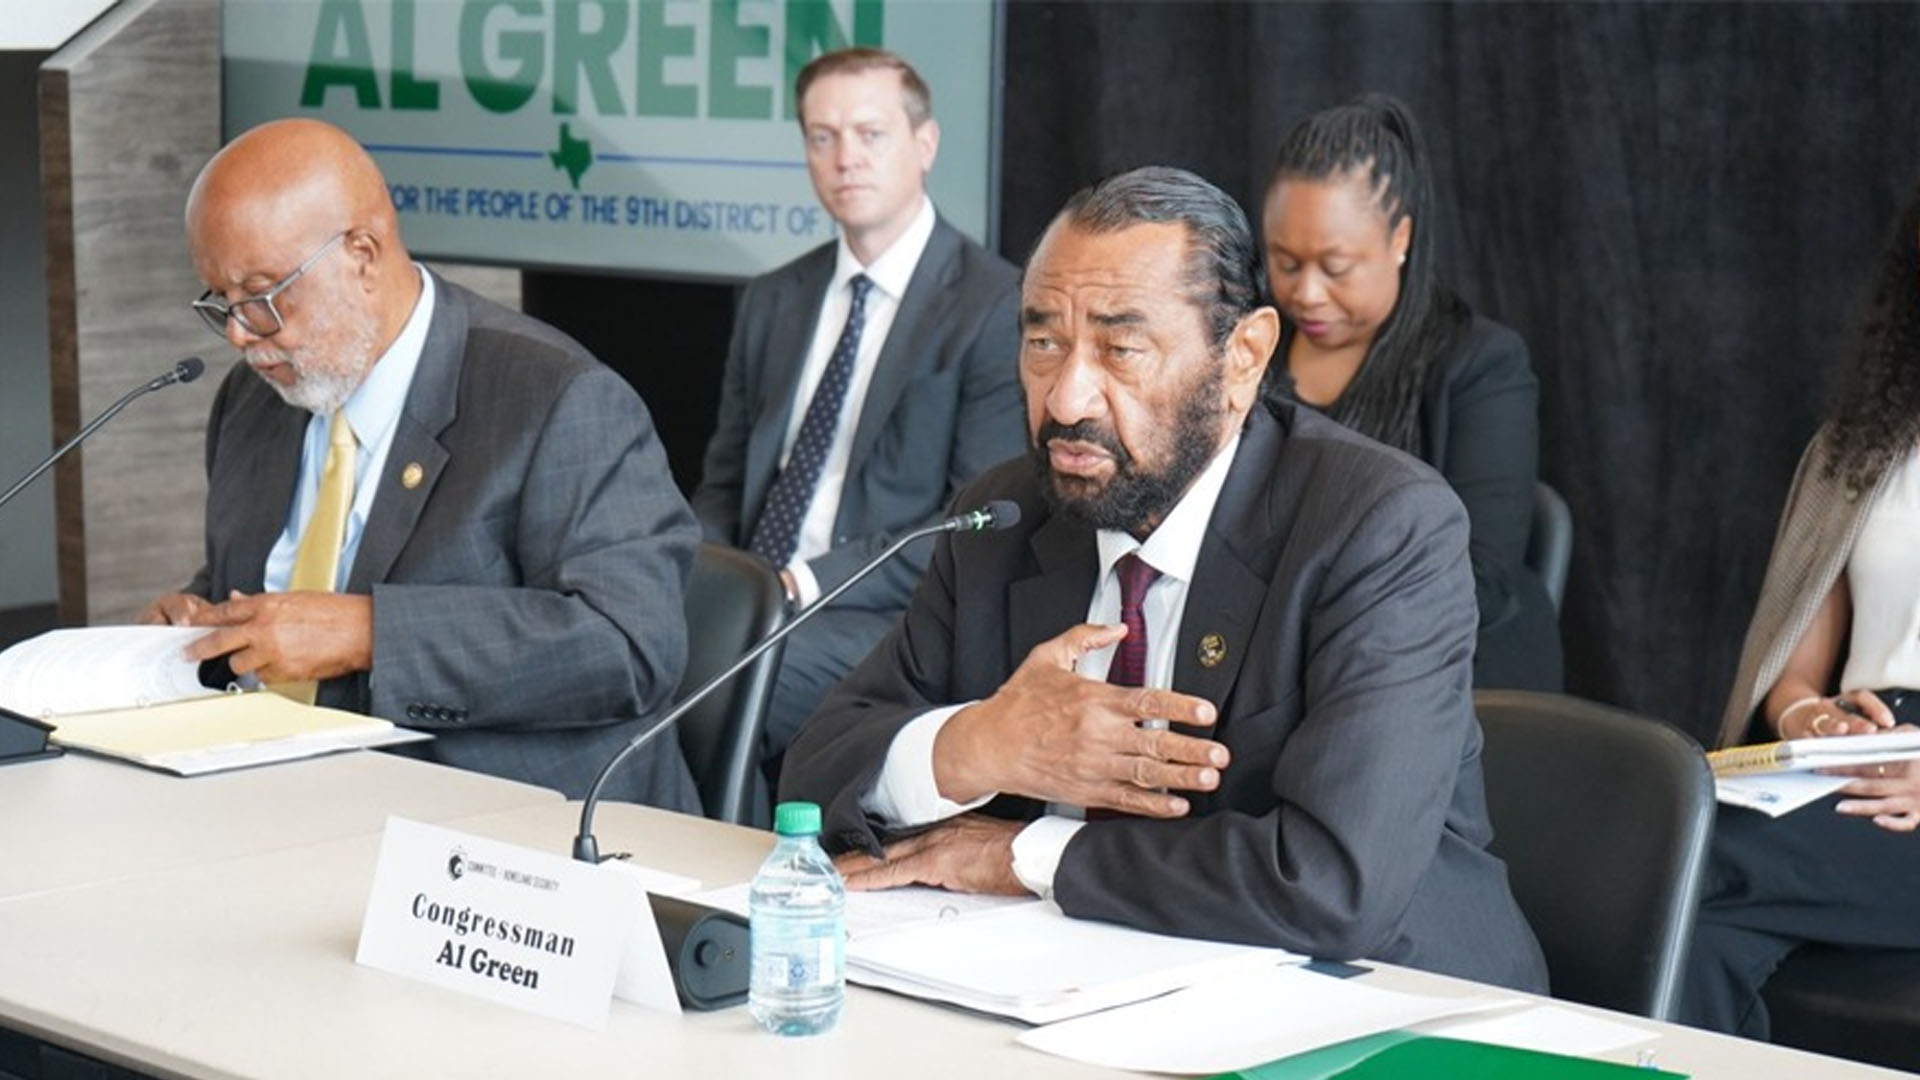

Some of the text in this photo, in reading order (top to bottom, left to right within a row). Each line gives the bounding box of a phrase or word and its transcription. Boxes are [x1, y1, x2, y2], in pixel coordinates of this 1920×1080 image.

[299, 0, 439, 111] AL
[389, 184, 420, 212] OR
[424, 186, 462, 216] THE
[466, 188, 539, 220] PEOPLE
[544, 191, 573, 221] OF
[581, 194, 620, 225] THE
[625, 195, 669, 228] 9TH
[675, 200, 781, 235] DISTRICT
[787, 205, 820, 236] OF
[411, 892, 575, 958] Congressman
[436, 939, 539, 990] Al Green
